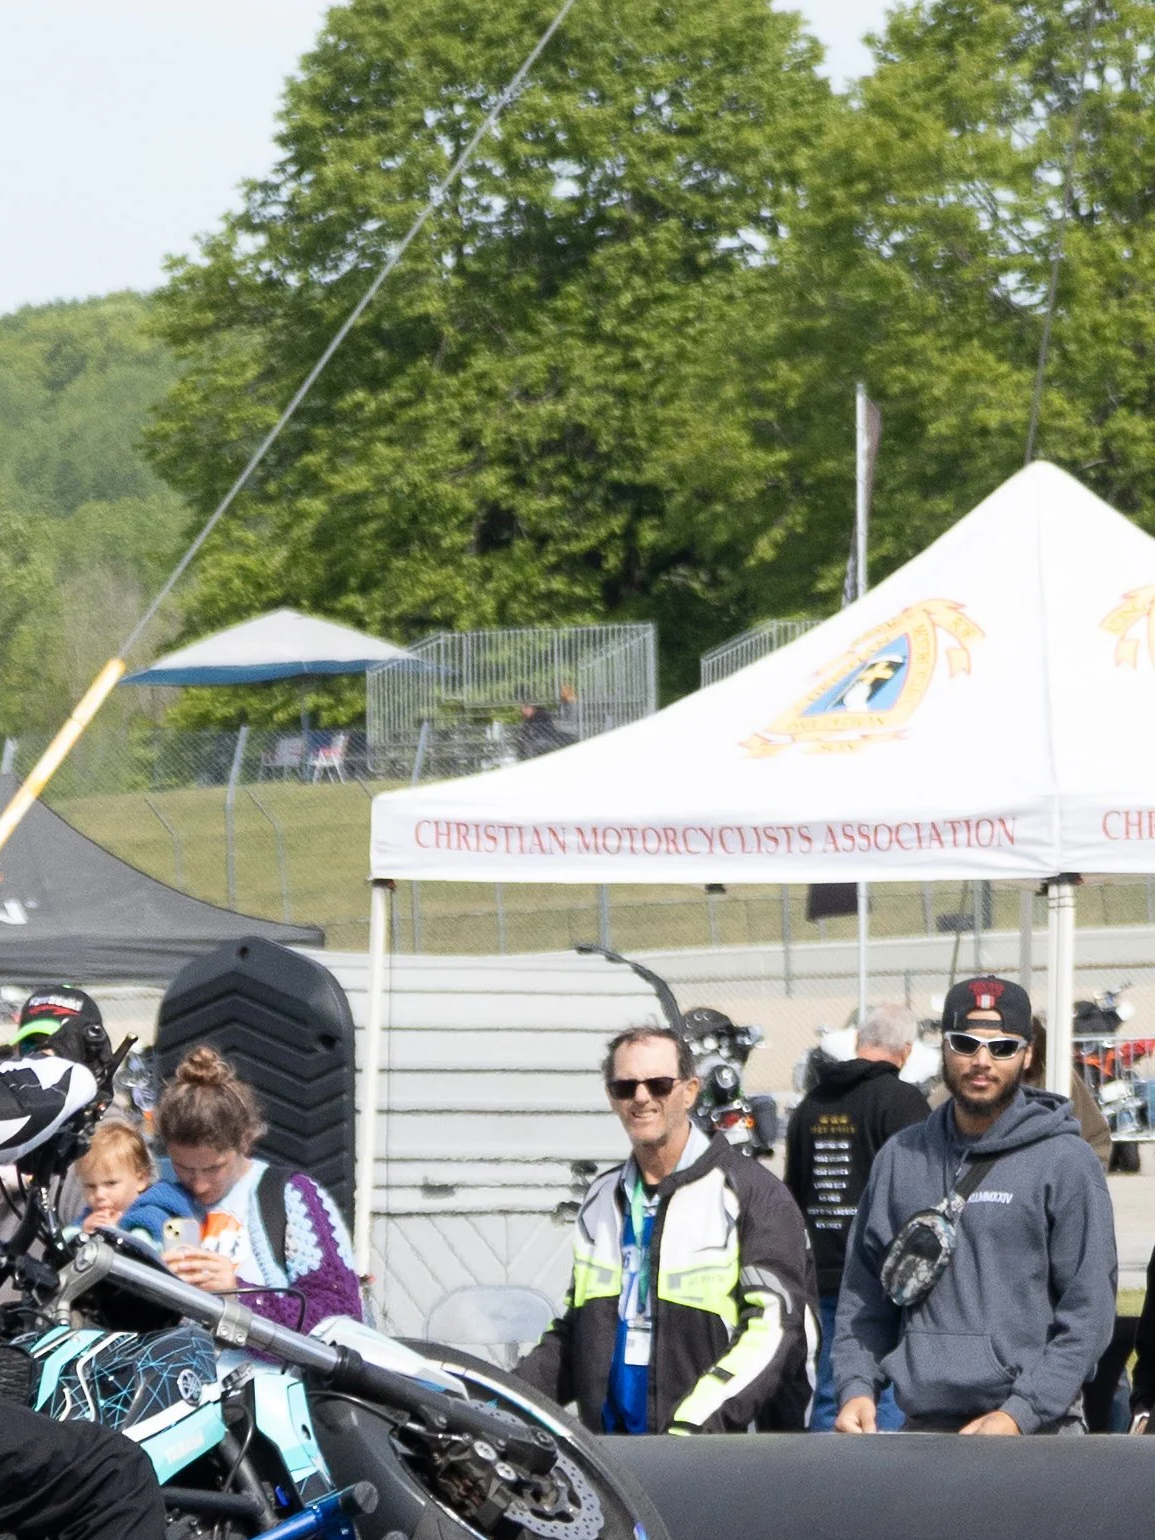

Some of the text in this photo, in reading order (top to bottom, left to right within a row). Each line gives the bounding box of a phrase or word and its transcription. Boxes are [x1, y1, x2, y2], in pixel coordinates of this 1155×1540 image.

[414, 816, 1018, 856] CHRISTIAN MOTORCYCLISTS ASSOCIATION
